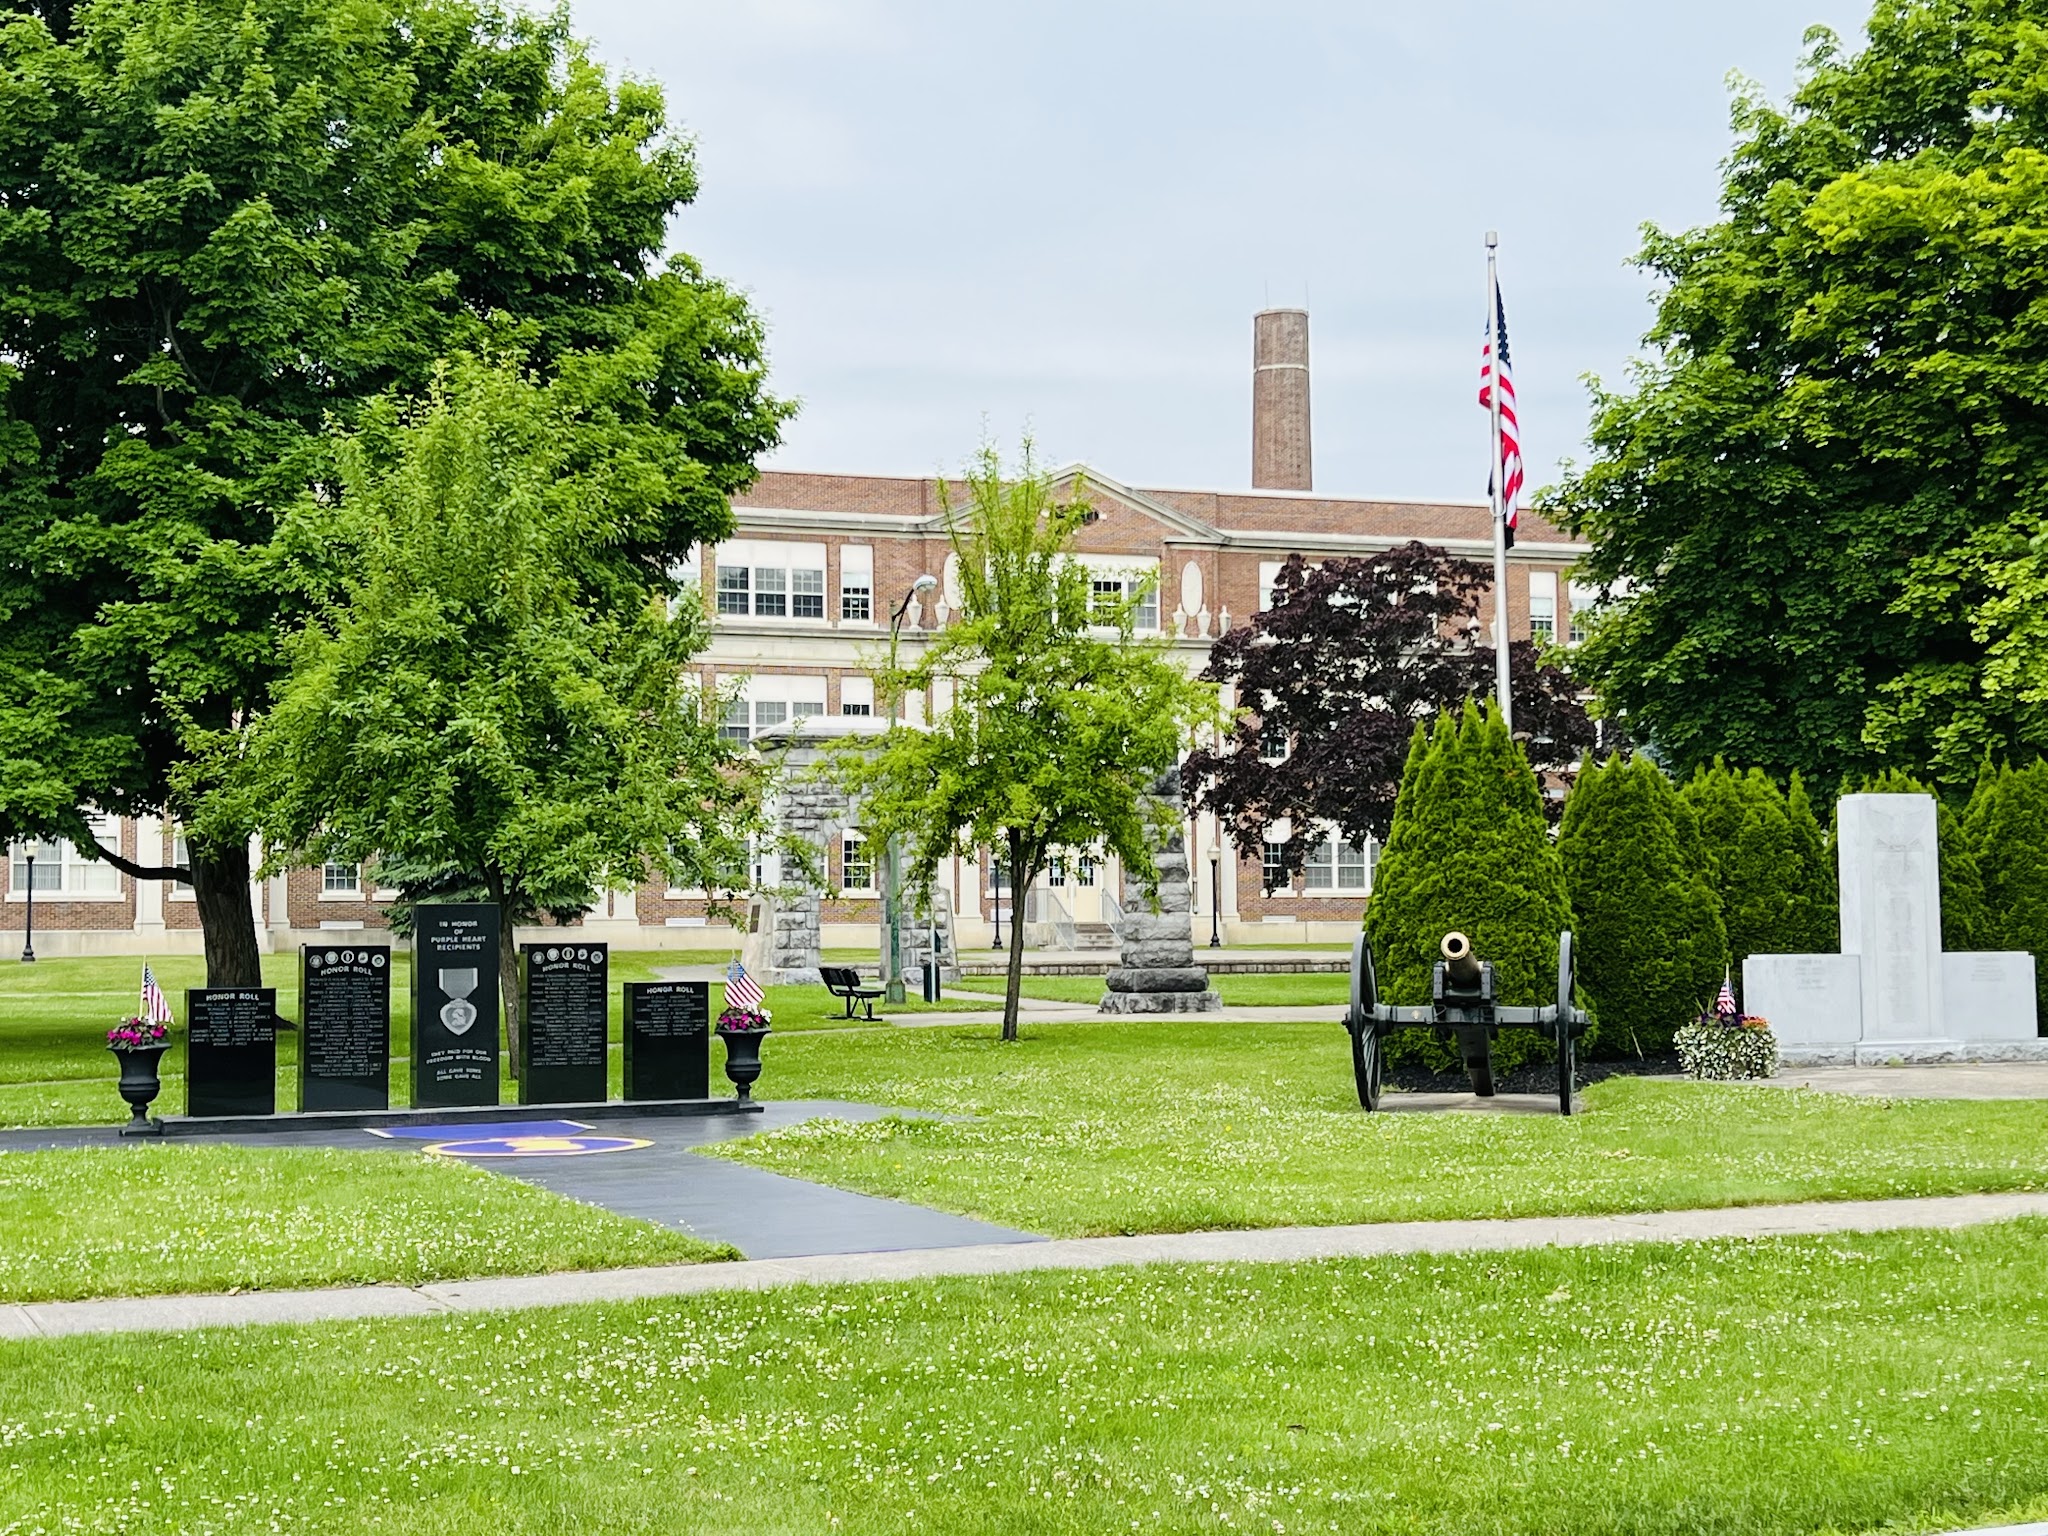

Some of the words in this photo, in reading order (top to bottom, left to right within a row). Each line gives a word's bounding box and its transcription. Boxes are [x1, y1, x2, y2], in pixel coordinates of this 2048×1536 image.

[451, 920, 478, 928] HONOR
[453, 928, 464, 936] OF
[461, 935, 487, 943] HEART
[436, 943, 481, 951] RECIPIENTS
[320, 965, 350, 976] HONOR
[353, 965, 373, 976] ROLL
[542, 962, 570, 973] HONOR
[572, 962, 591, 972] ROLL
[646, 985, 673, 995] HONOR
[675, 985, 695, 994] ROLL
[206, 992, 236, 1002] HONOR
[239, 992, 260, 1001] ROLL
